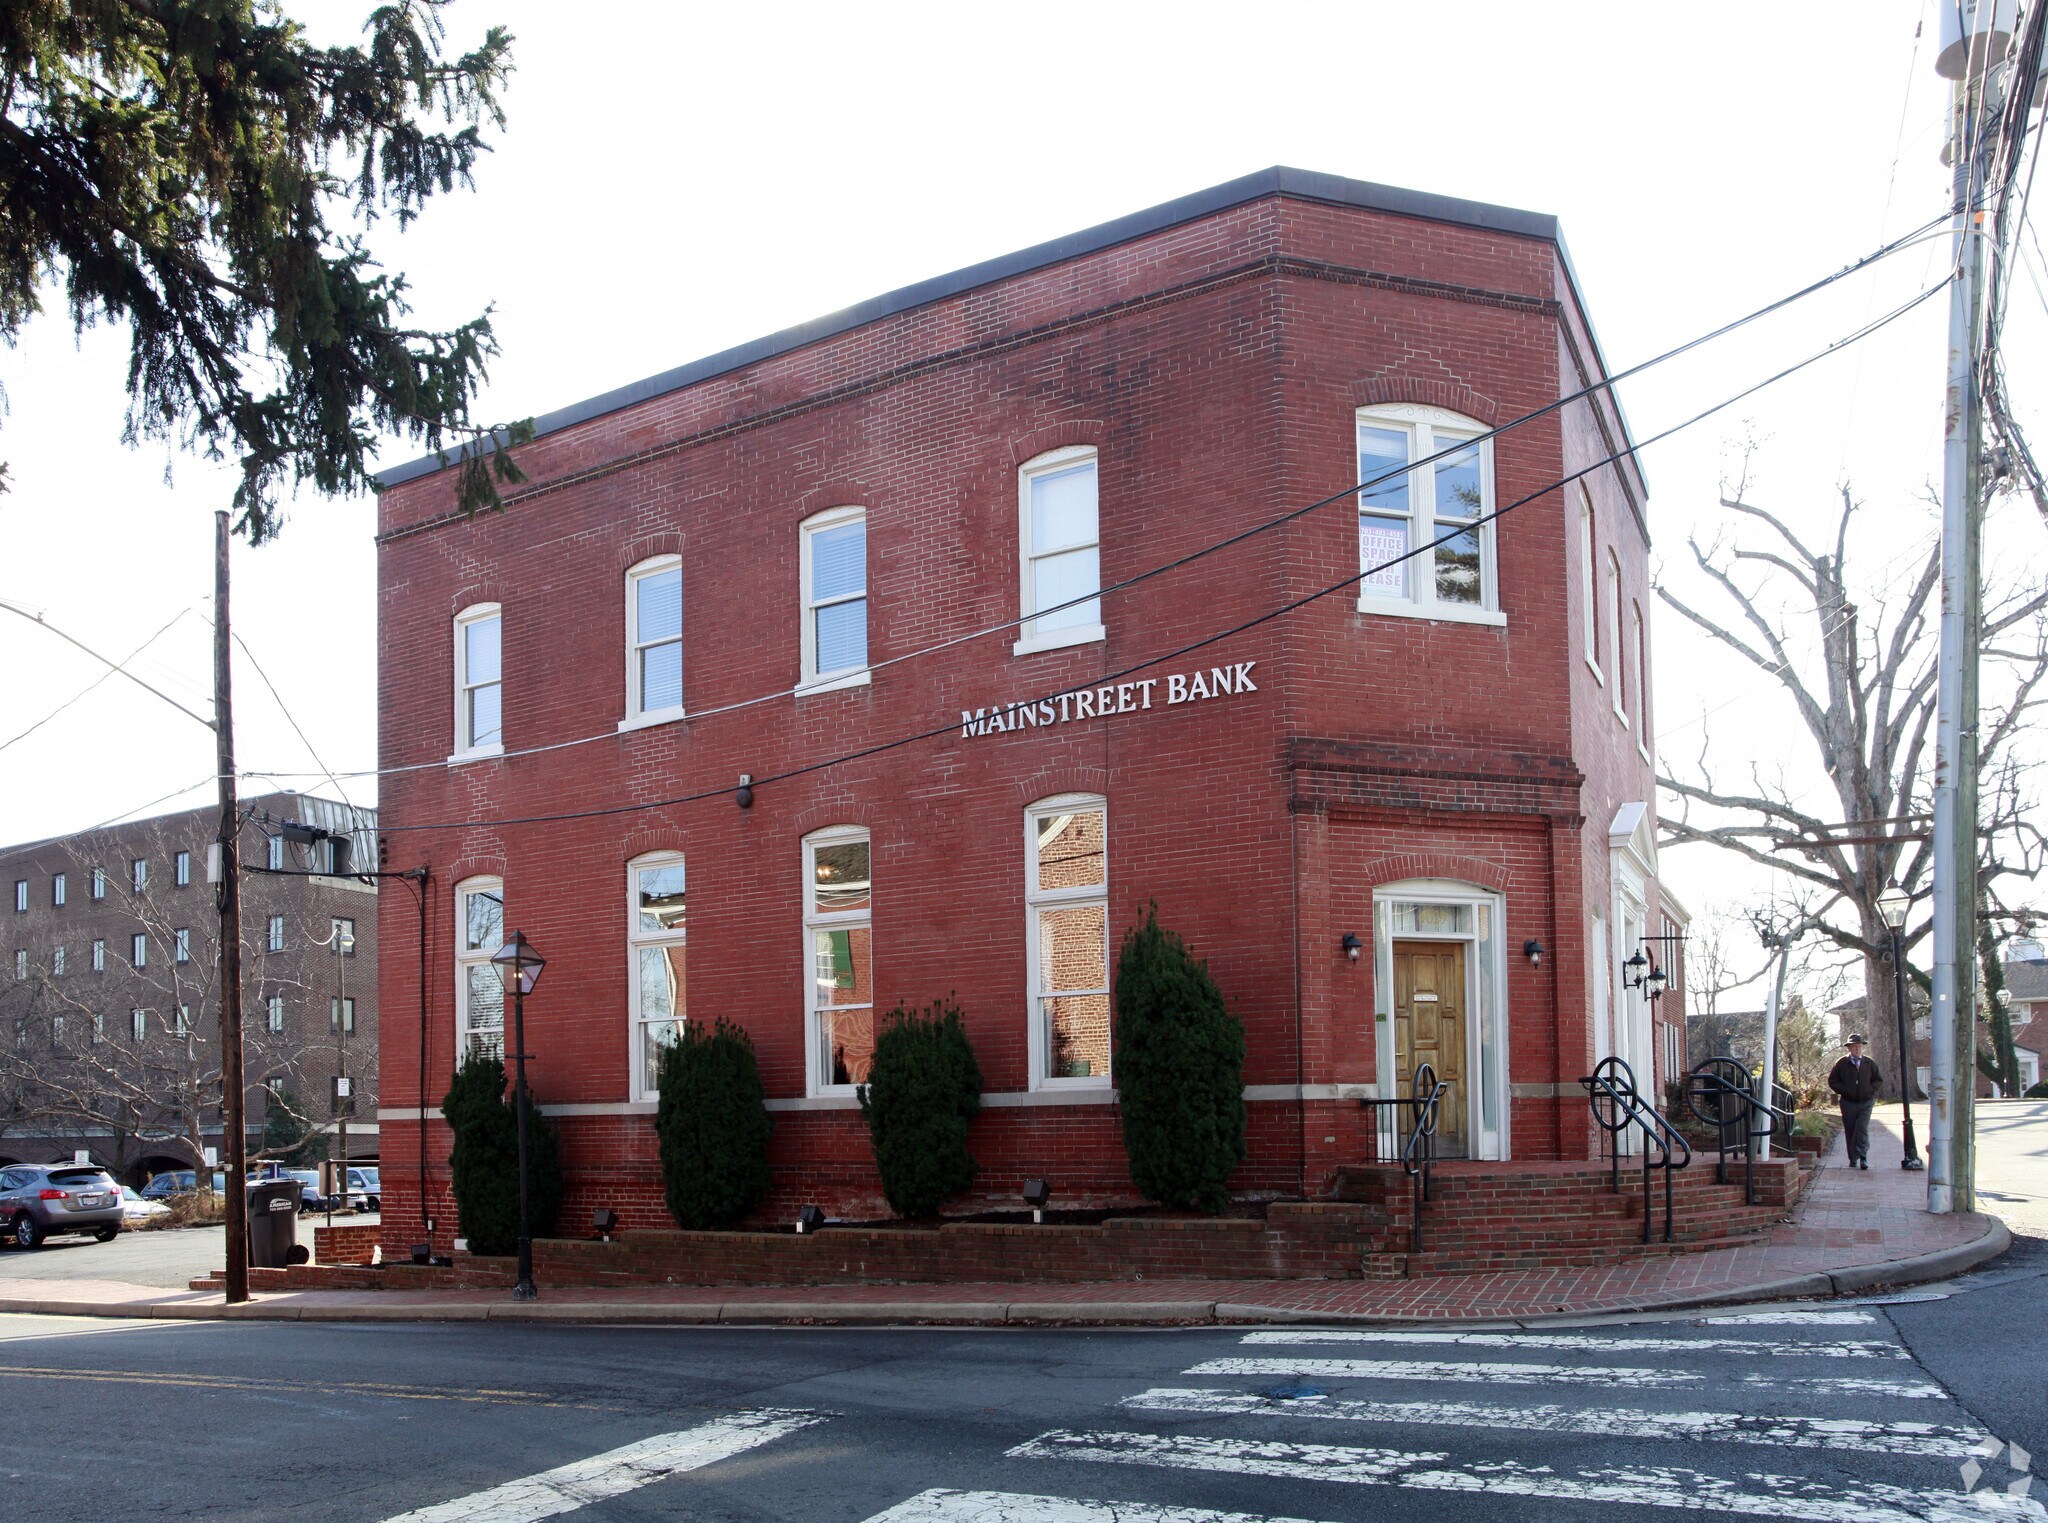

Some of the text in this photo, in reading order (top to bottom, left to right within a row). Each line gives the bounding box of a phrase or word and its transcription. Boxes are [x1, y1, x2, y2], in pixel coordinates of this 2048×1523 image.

[1362, 536, 1402, 550] OFFICE
[1362, 547, 1402, 561] SPACE
[961, 661, 1258, 738] MAINSTREET BANK
